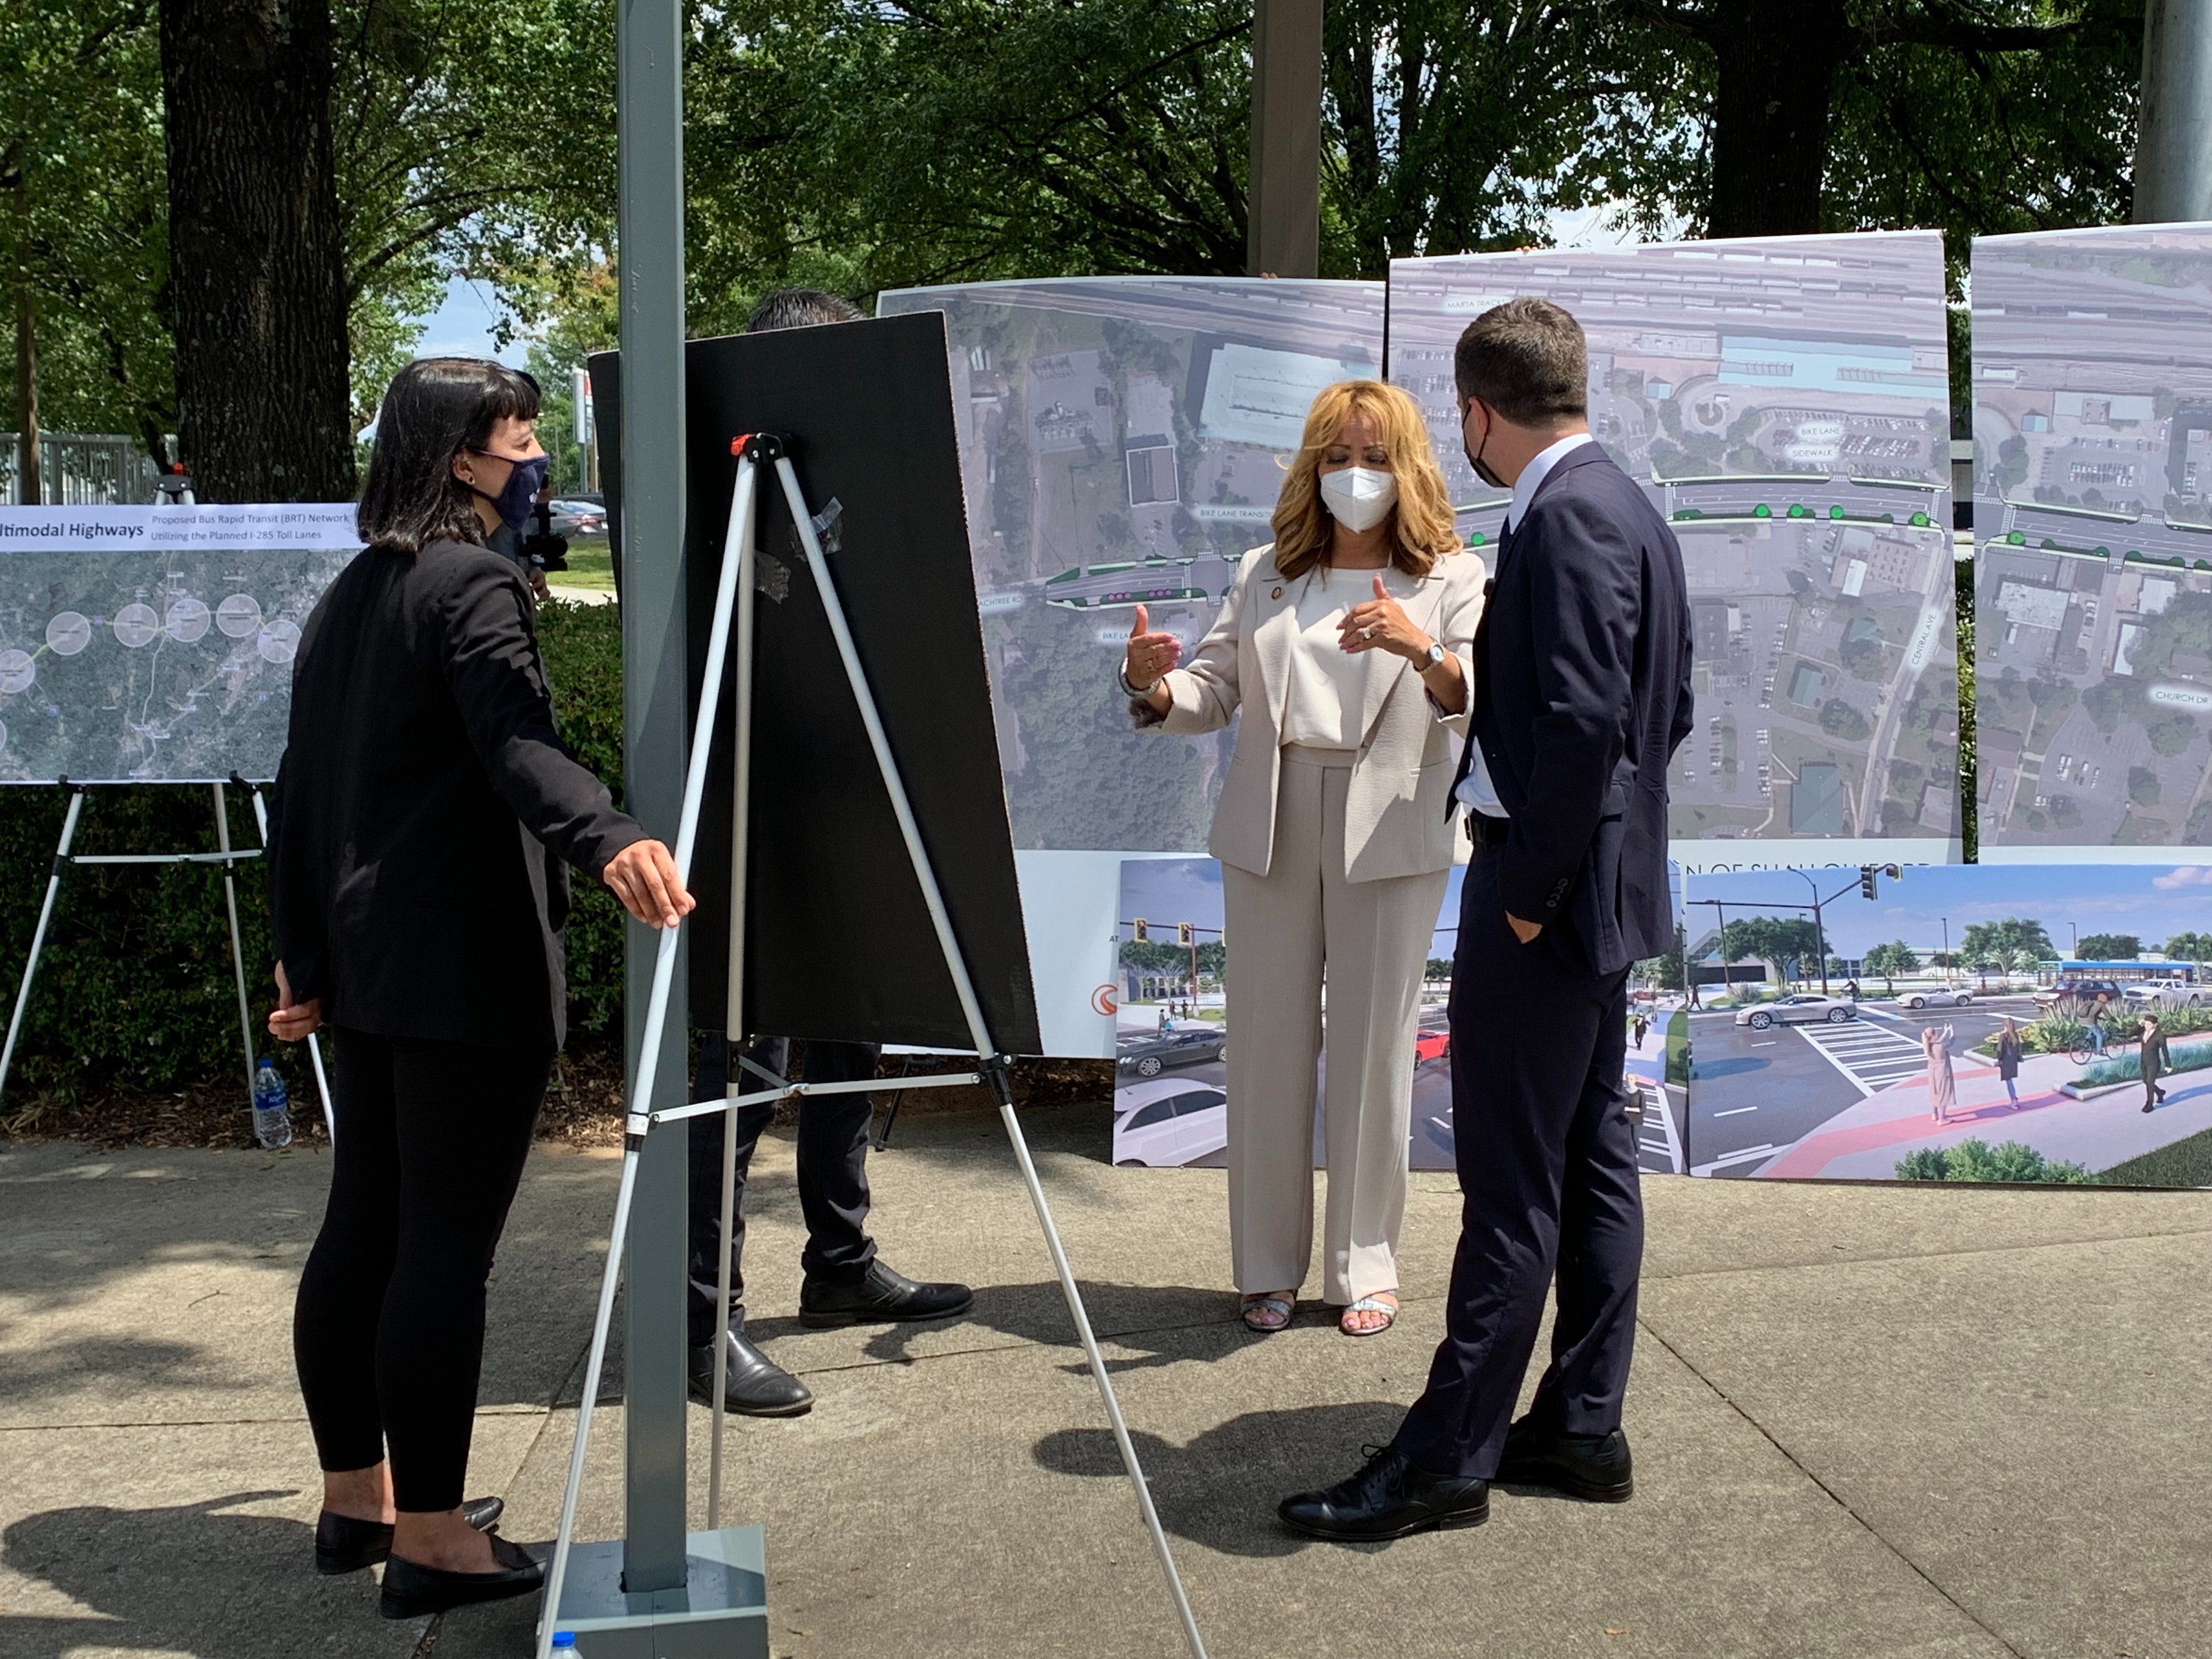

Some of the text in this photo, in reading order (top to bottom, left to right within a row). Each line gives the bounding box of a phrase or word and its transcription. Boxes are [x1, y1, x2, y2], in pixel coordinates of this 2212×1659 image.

[1792, 449, 1833, 458] SIDEWALK
[152, 513, 349, 526] Proposed Bus Rapid Transit (BRT) Network
[69, 522, 144, 539] Highways
[150, 530, 322, 542] Utilizing the Planned I-285 Toll Lanes
[1911, 613, 1937, 665] CENTRAL AVE
[2155, 691, 2209, 704] CHURCH DR
